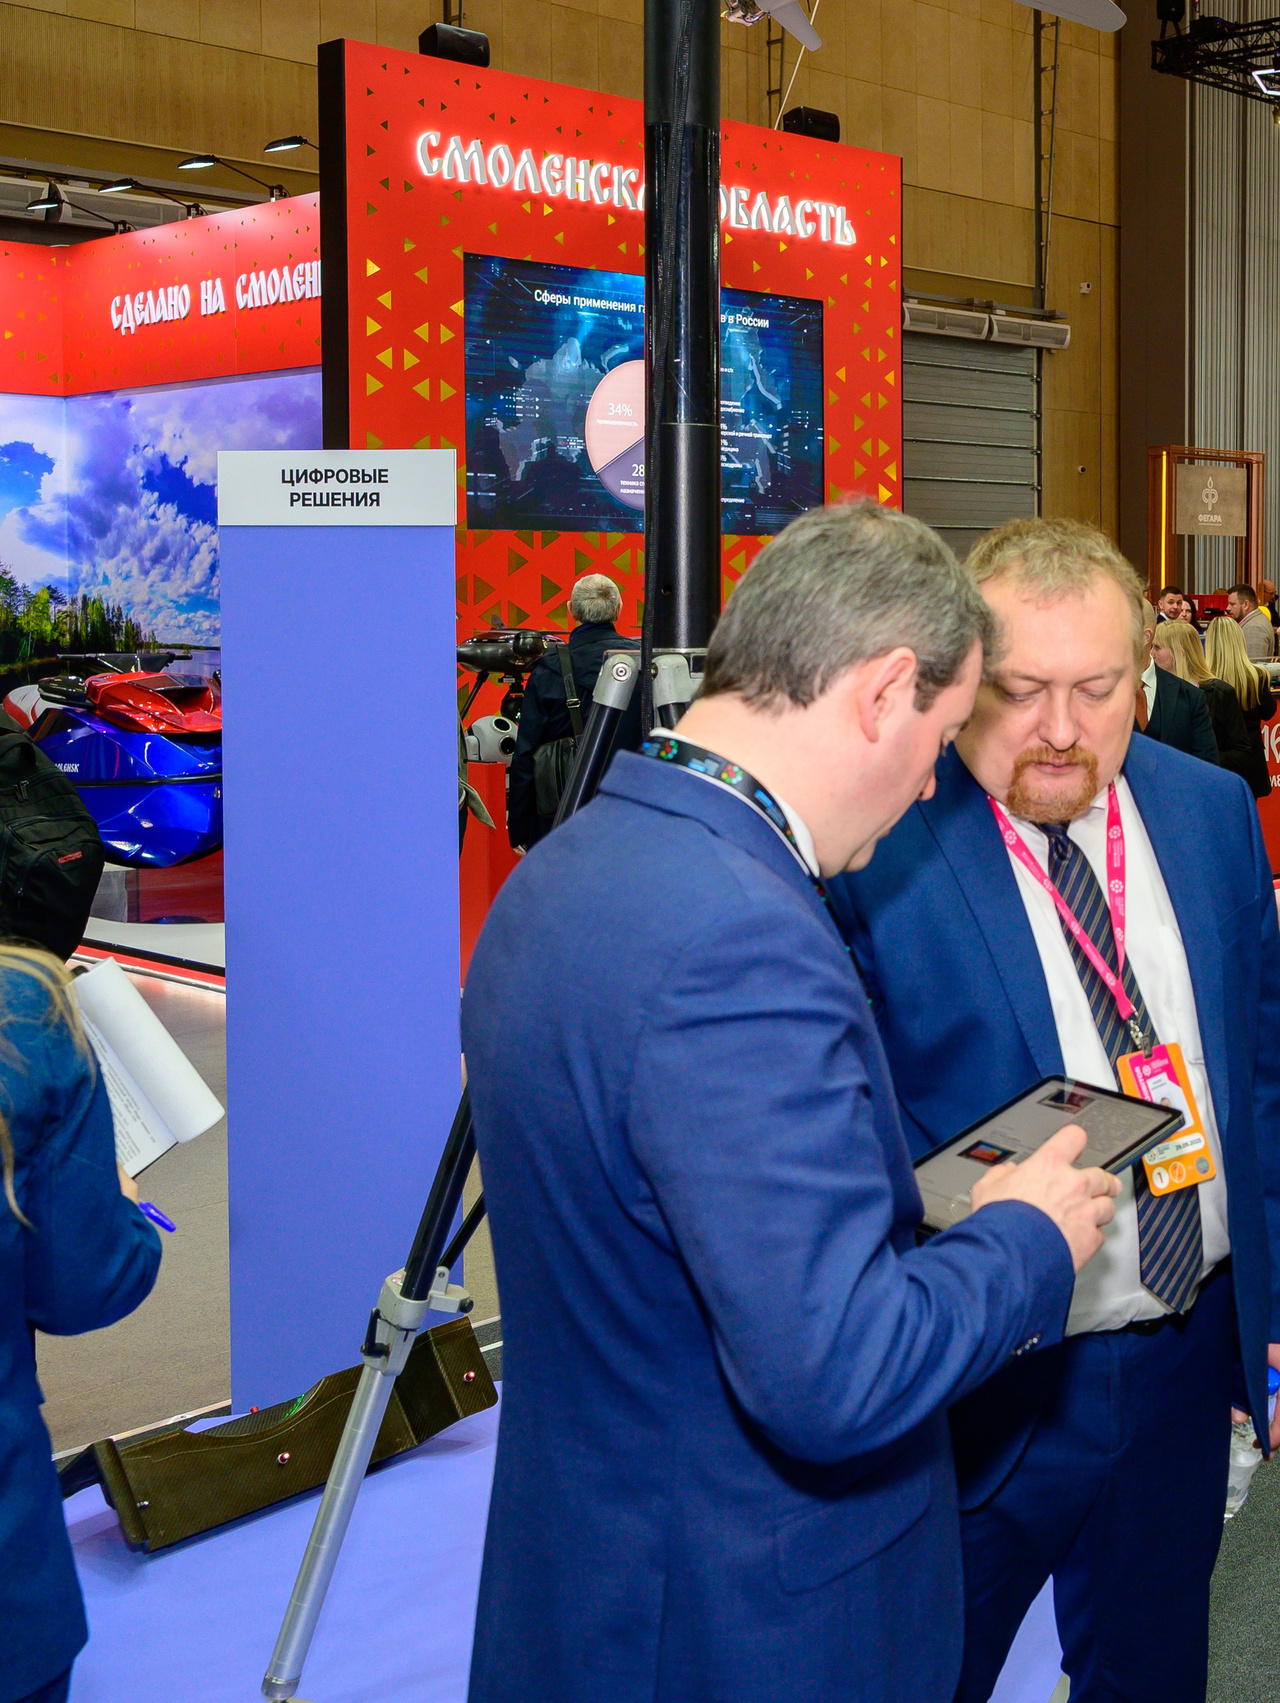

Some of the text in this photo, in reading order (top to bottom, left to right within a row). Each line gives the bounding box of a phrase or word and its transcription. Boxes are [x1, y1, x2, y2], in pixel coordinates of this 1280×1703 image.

[110, 283, 191, 336] СДЕЛАНО
[200, 277, 226, 316] НА
[534, 289, 571, 307] Сферы
[573, 296, 637, 313] применения
[728, 314, 735, 324] в
[735, 313, 770, 329] России
[608, 402, 633, 417] 34%
[281, 468, 389, 487] ЦИФРОВЫЕ
[289, 491, 381, 507] РЕШЕНИЯ
[1197, 513, 1223, 523] ФЕГАРА
